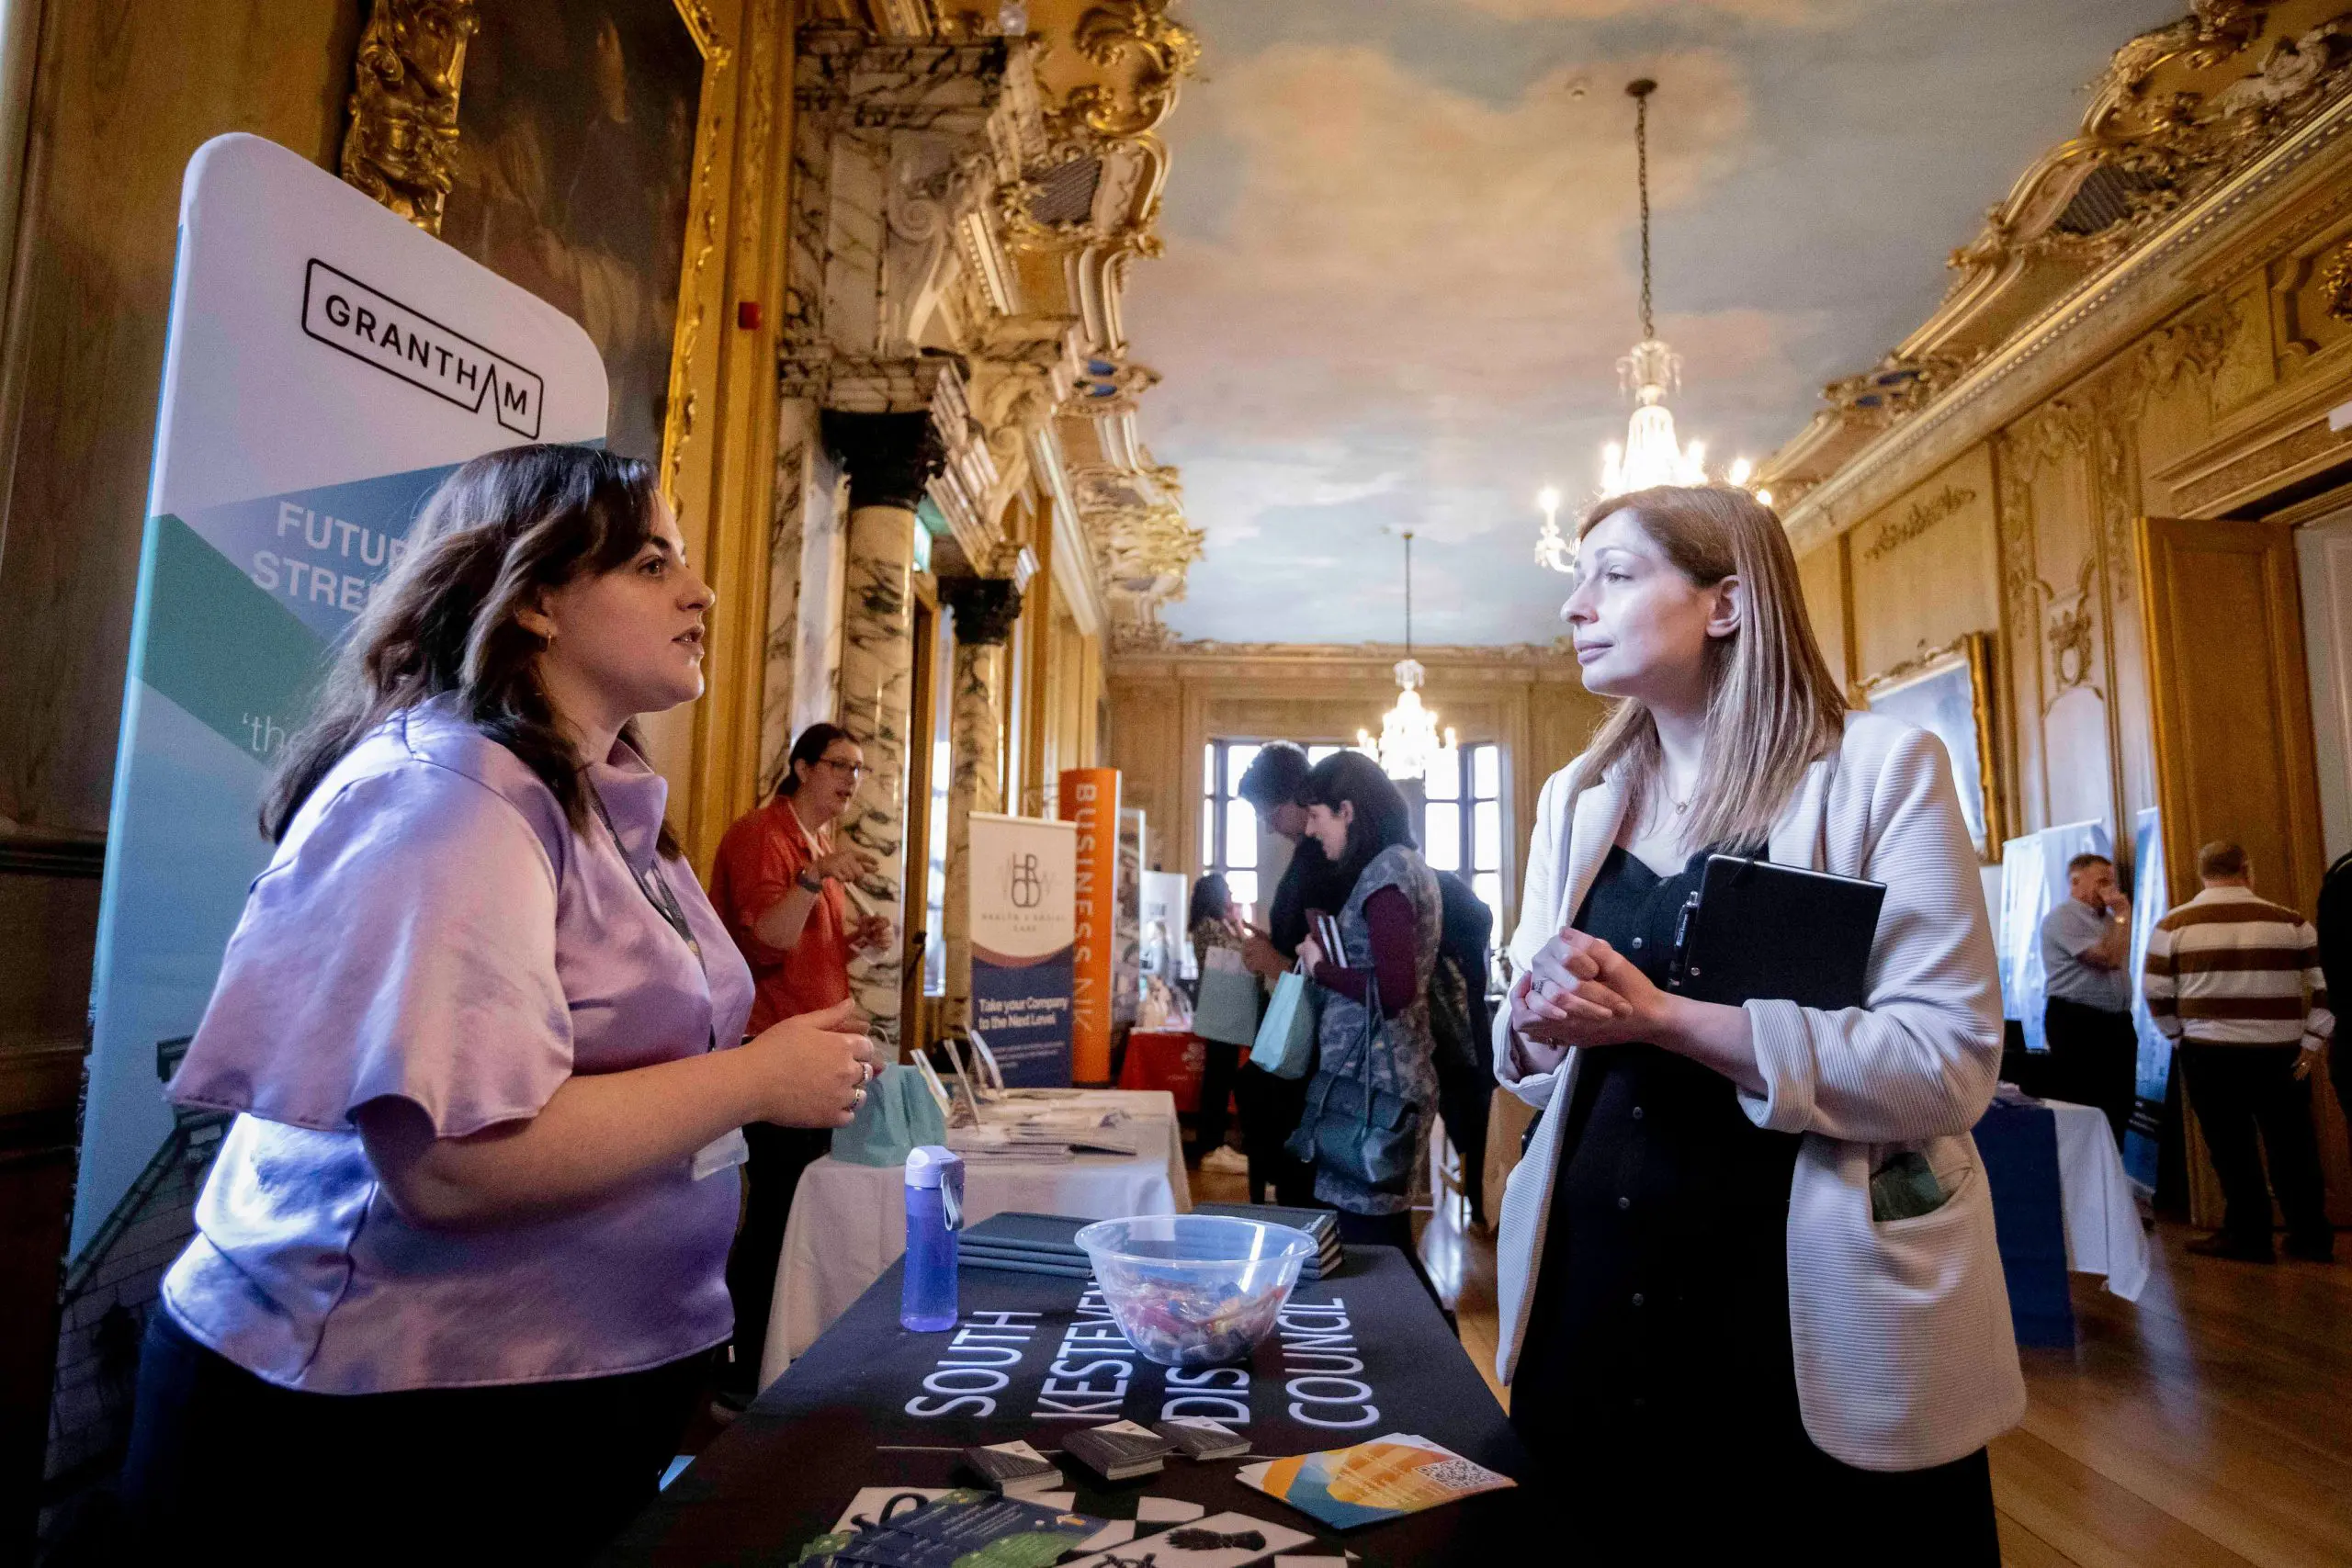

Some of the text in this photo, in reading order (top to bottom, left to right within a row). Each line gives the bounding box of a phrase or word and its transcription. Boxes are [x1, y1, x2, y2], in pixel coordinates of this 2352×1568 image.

[325, 294, 527, 415] GRANTHAM
[253, 550, 368, 614] STRE
[1074, 784, 1097, 964] BUSINESS
[978, 996, 1069, 1014] Take your Company
[978, 1011, 1057, 1030] to the Next Level
[904, 1310, 1044, 1417] SOUTH
[1161, 1366, 1250, 1424] DIS
[1276, 1297, 1380, 1428] COUNCIL
